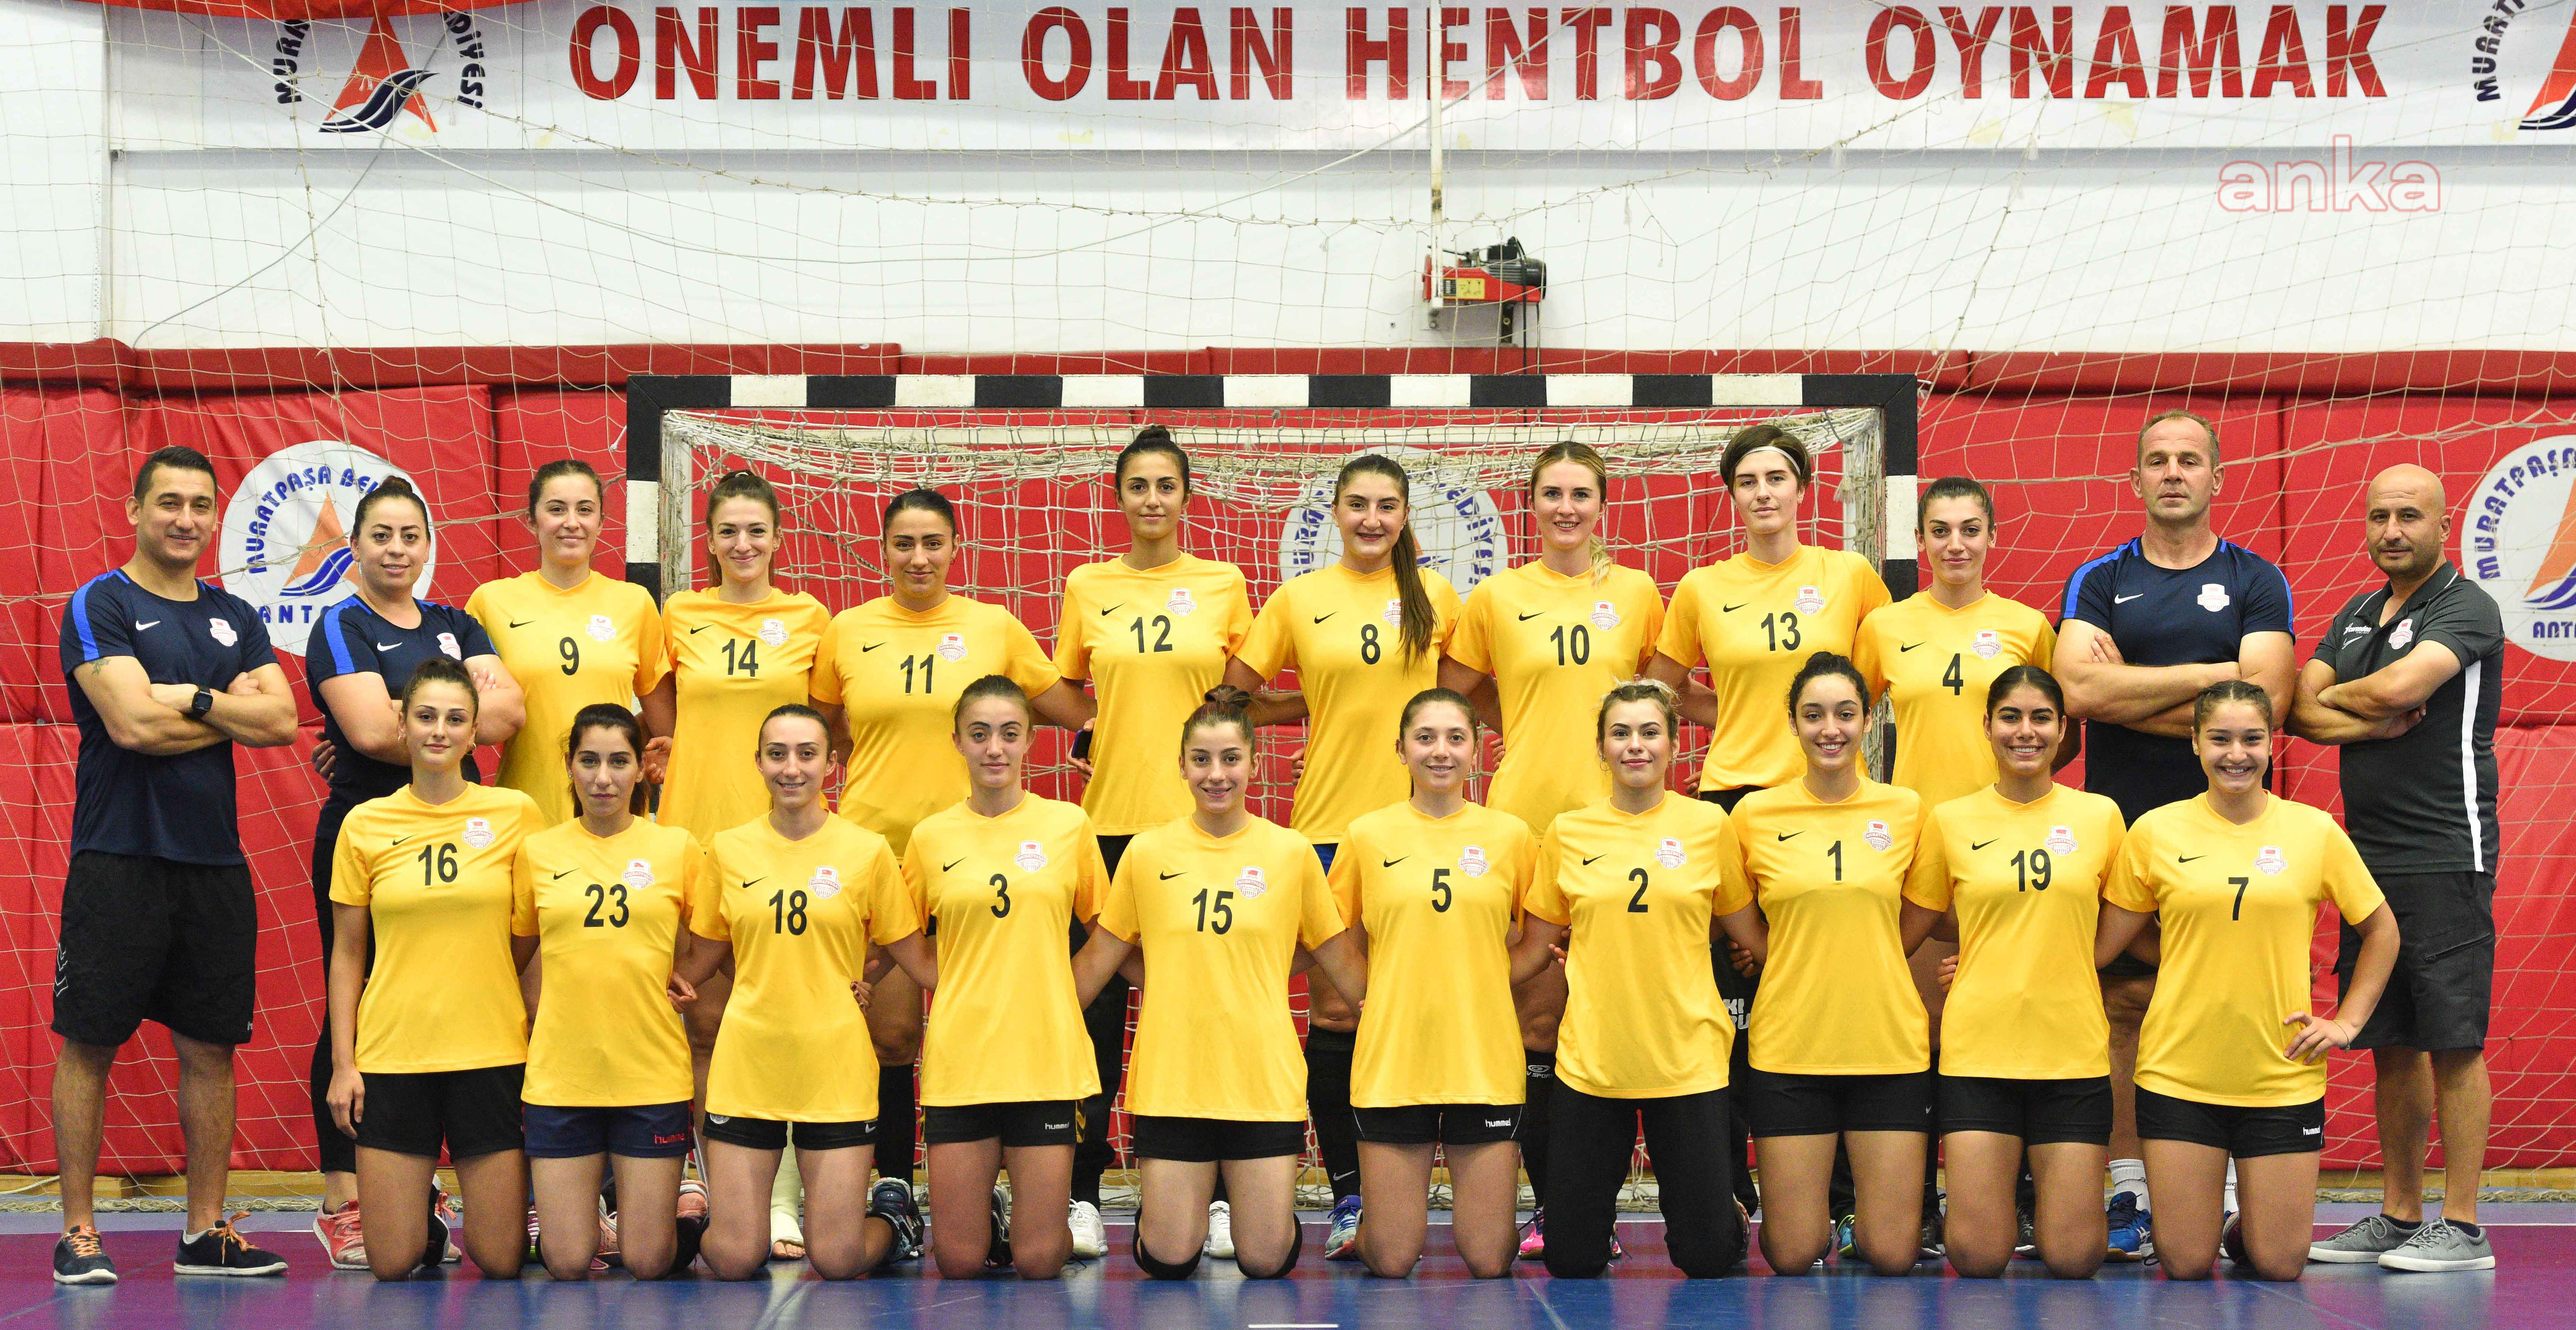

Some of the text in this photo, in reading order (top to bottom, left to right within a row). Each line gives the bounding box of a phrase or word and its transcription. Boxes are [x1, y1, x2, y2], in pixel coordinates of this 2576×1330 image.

[1021, 6, 1292, 101] OLAN
[1346, 6, 1823, 101] HENTBOL
[1865, 5, 2387, 100] OYNAMAK
[2472, 0, 2525, 102] MURAT
[1130, 615, 1173, 654] 12
[1361, 624, 1381, 665] 8
[1550, 624, 1590, 666] 10
[1761, 612, 1801, 651] 13
[2533, 621, 2576, 638] ANT
[559, 637, 579, 676] 9
[722, 638, 759, 677] 14
[900, 654, 934, 694] 11
[1942, 653, 1964, 696] 4
[418, 842, 458, 886] 16
[1827, 840, 1842, 881] 1
[2010, 848, 2052, 892] 19
[583, 883, 629, 928] 23
[989, 873, 1011, 919] 3
[1192, 888, 1234, 935] 15
[1431, 868, 1452, 913] 5
[1627, 867, 1648, 913] 2
[2228, 877, 2249, 921] 7
[769, 889, 807, 936] 18
[1045, 1121, 1069, 1130] hummel
[1485, 1117, 1511, 1128] hummel
